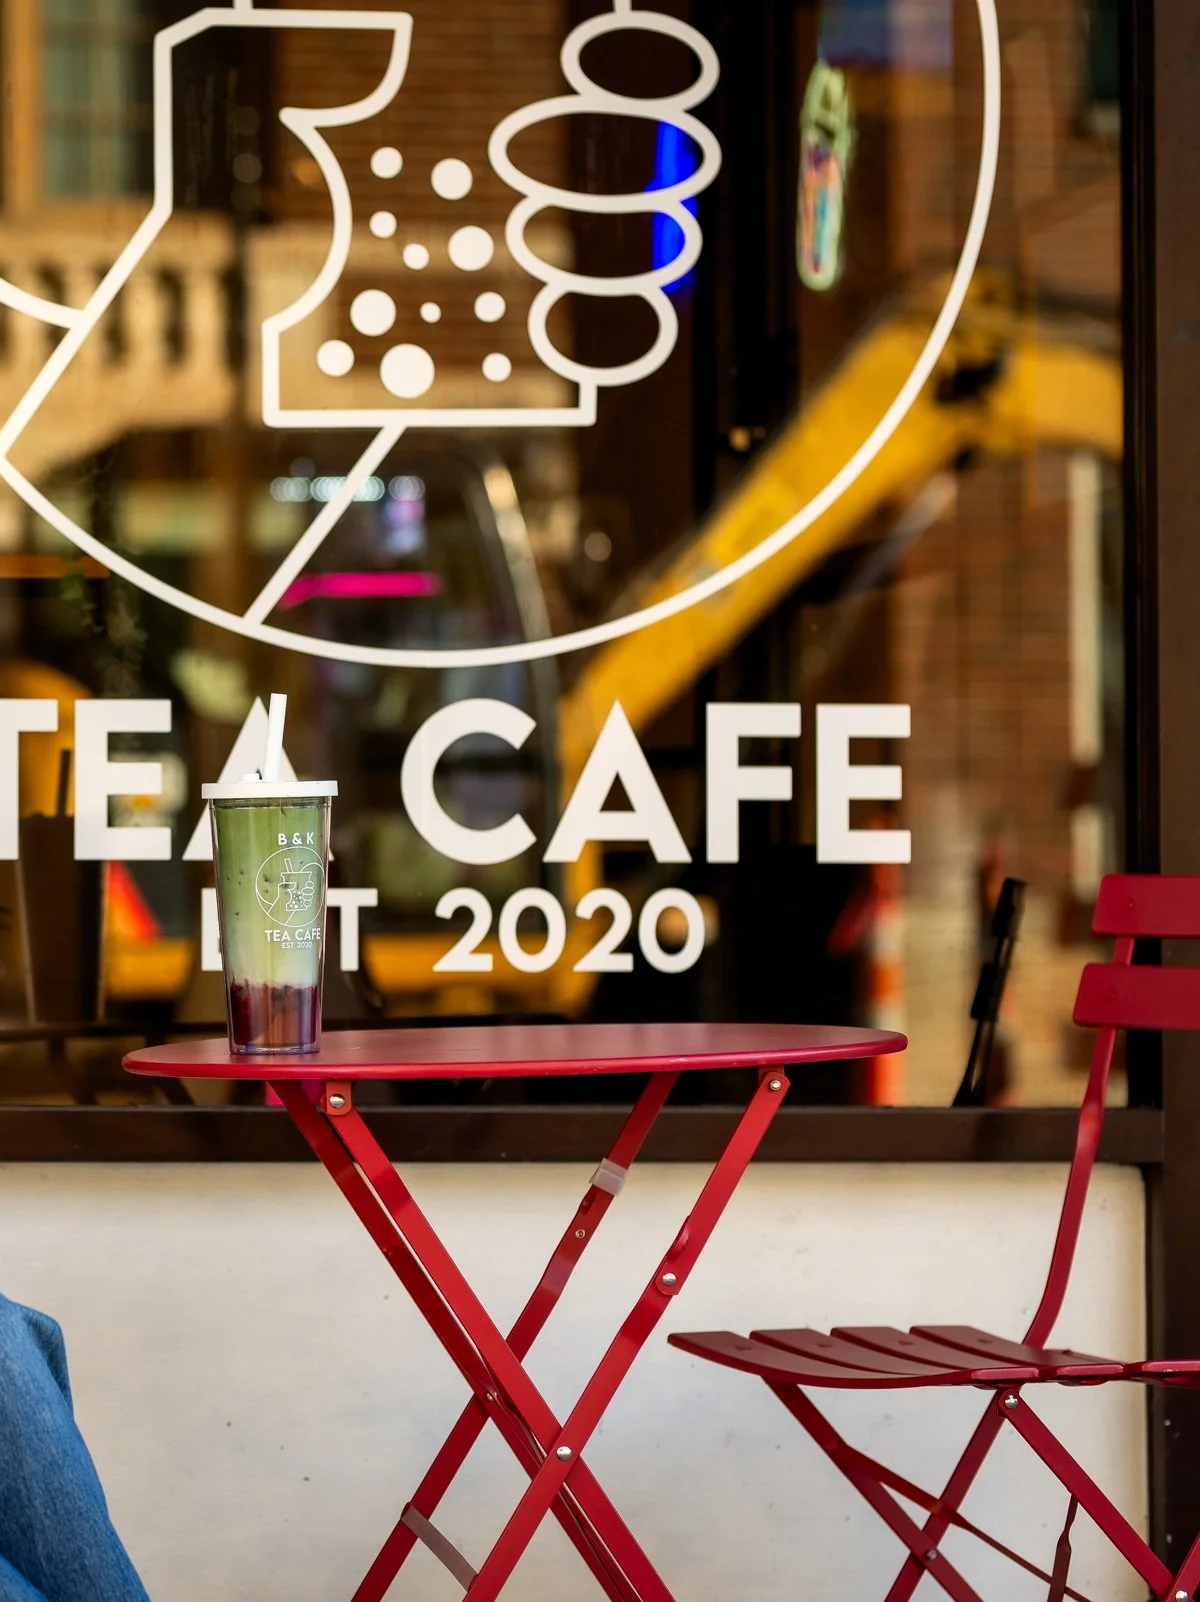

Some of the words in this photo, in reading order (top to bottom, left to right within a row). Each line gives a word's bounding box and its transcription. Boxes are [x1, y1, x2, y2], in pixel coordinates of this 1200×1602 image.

[403, 699, 911, 863] CAFE
[278, 833, 288, 845] B
[292, 833, 302, 845] &
[306, 832, 314, 845] K
[265, 929, 291, 942] TEA
[294, 928, 321, 941] CAFE
[434, 888, 705, 972] 2020
[296, 941, 313, 949] 2020
